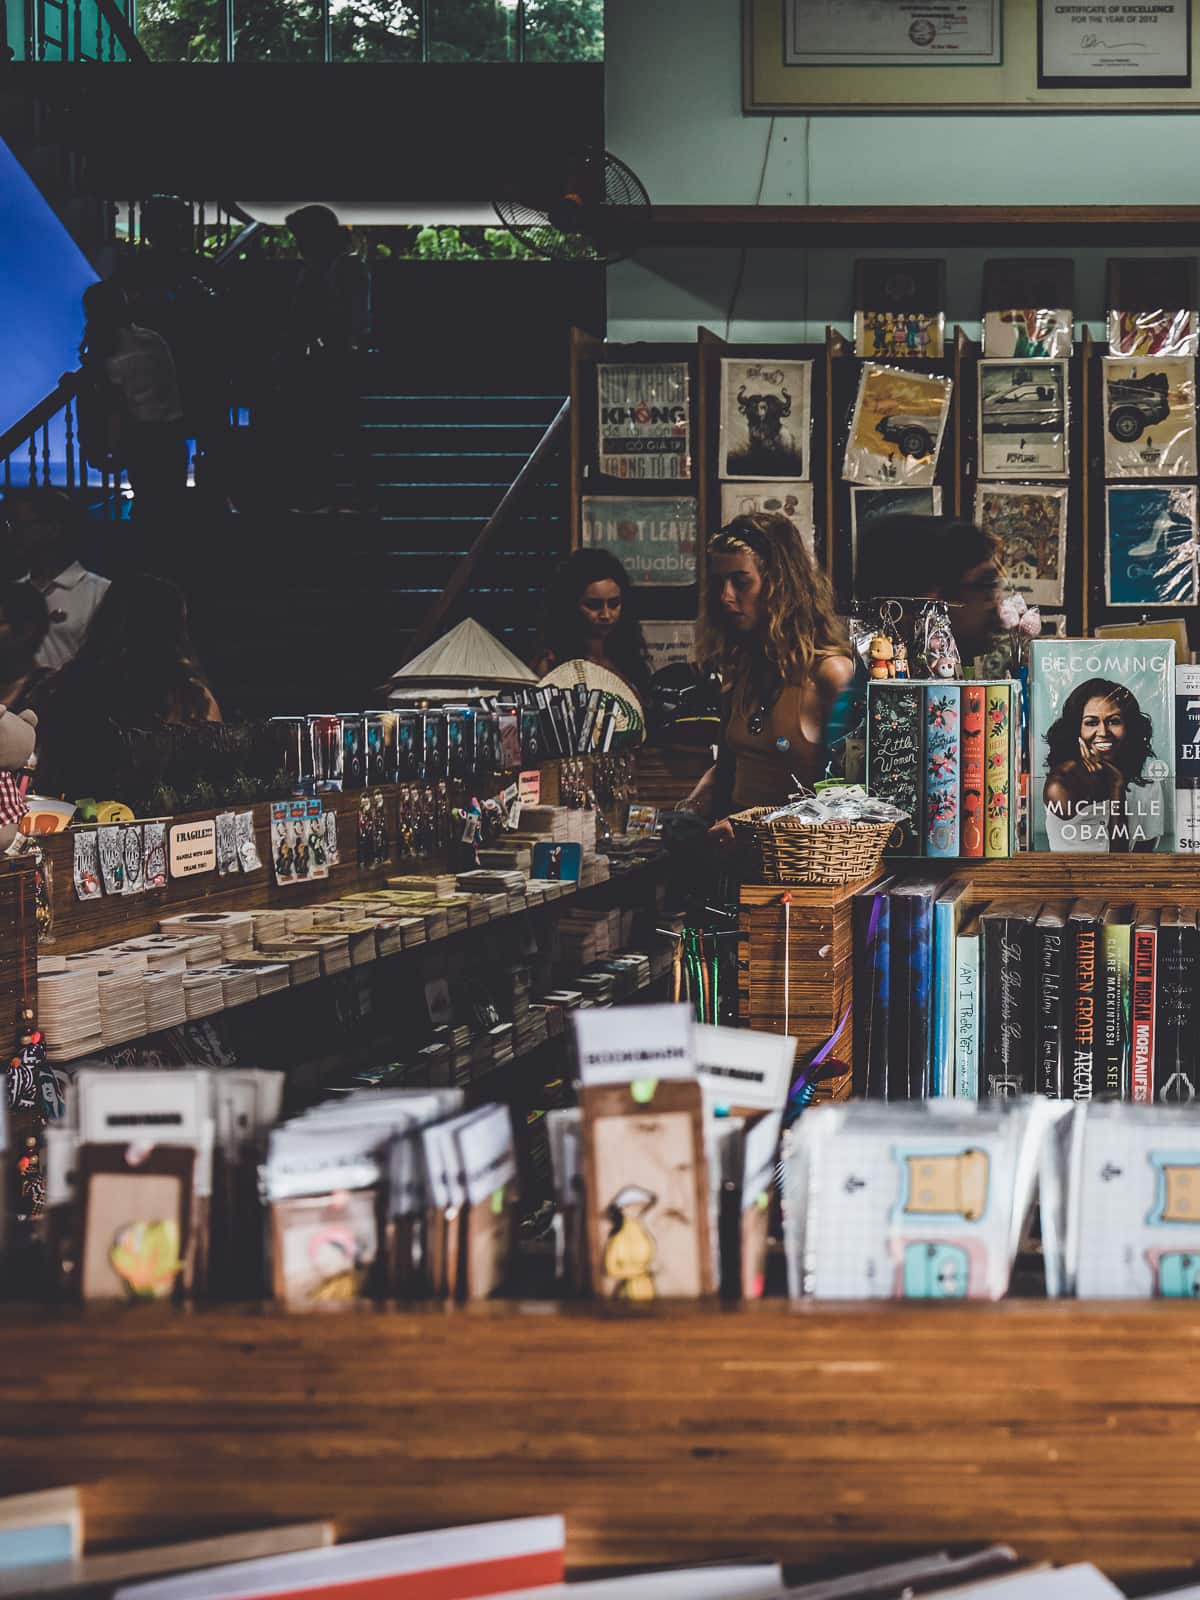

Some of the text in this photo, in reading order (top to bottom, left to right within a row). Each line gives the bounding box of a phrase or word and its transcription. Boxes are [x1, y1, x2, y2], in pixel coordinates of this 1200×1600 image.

[1055, 5, 1174, 14] CERTIFICATE OF EXCELLENCE
[649, 520, 696, 541] LEAVE
[1041, 656, 1166, 672] BECOMING
[878, 736, 914, 756] Little
[874, 753, 917, 773] Women
[1047, 801, 1160, 816] MICHELLE
[1061, 824, 1147, 840] OBAMA
[1041, 935, 1060, 1014] Padma Lakshmi
[1136, 937, 1151, 1020] CAITLIN MORAN
[959, 991, 973, 1000] I
[1074, 932, 1095, 1046] LAUREN GROFF
[1105, 939, 1115, 1046] CLARE MACKINTOSH
[1000, 938, 1022, 1064] The Brothers Grimm
[1106, 1066, 1117, 1087] SEE
